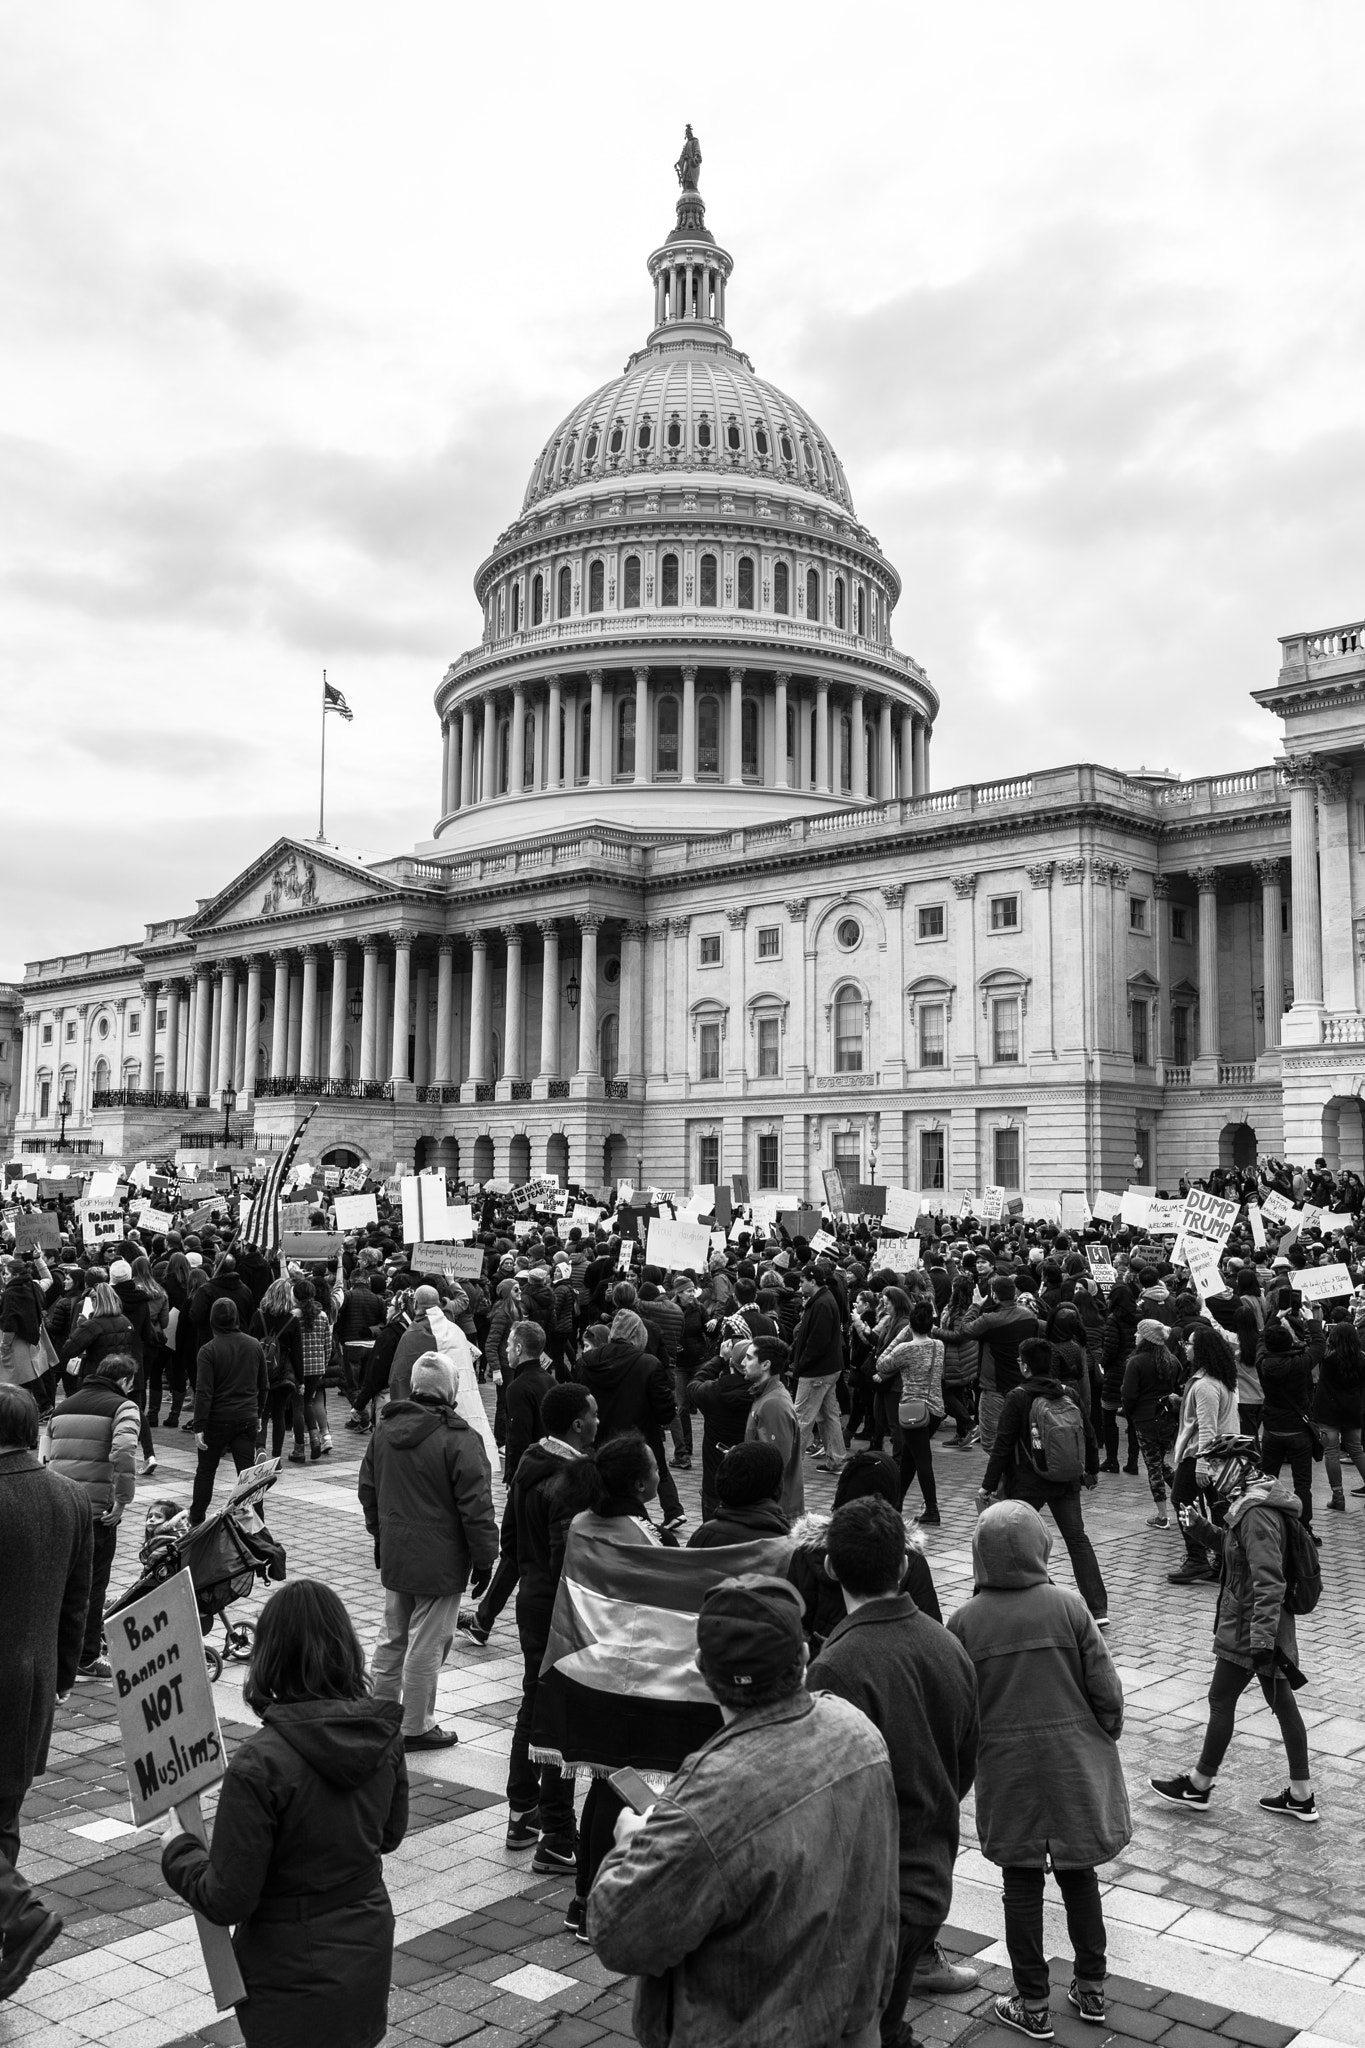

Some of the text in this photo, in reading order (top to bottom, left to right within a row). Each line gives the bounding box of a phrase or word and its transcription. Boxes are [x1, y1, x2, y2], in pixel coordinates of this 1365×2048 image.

[80, 1199, 92, 1207] GOP
[513, 1189, 524, 1198] NO
[524, 1181, 542, 1193] HATE
[516, 1188, 546, 1205] NO FEAR
[1186, 1191, 1235, 1219] DUMP
[1182, 1209, 1231, 1238] TRUMP
[879, 1239, 908, 1249] HUG ME
[123, 1607, 169, 1652] Ban
[115, 1641, 180, 1698] Bannon
[141, 1674, 184, 1734] NOT
[134, 1730, 220, 1802] Muslims
